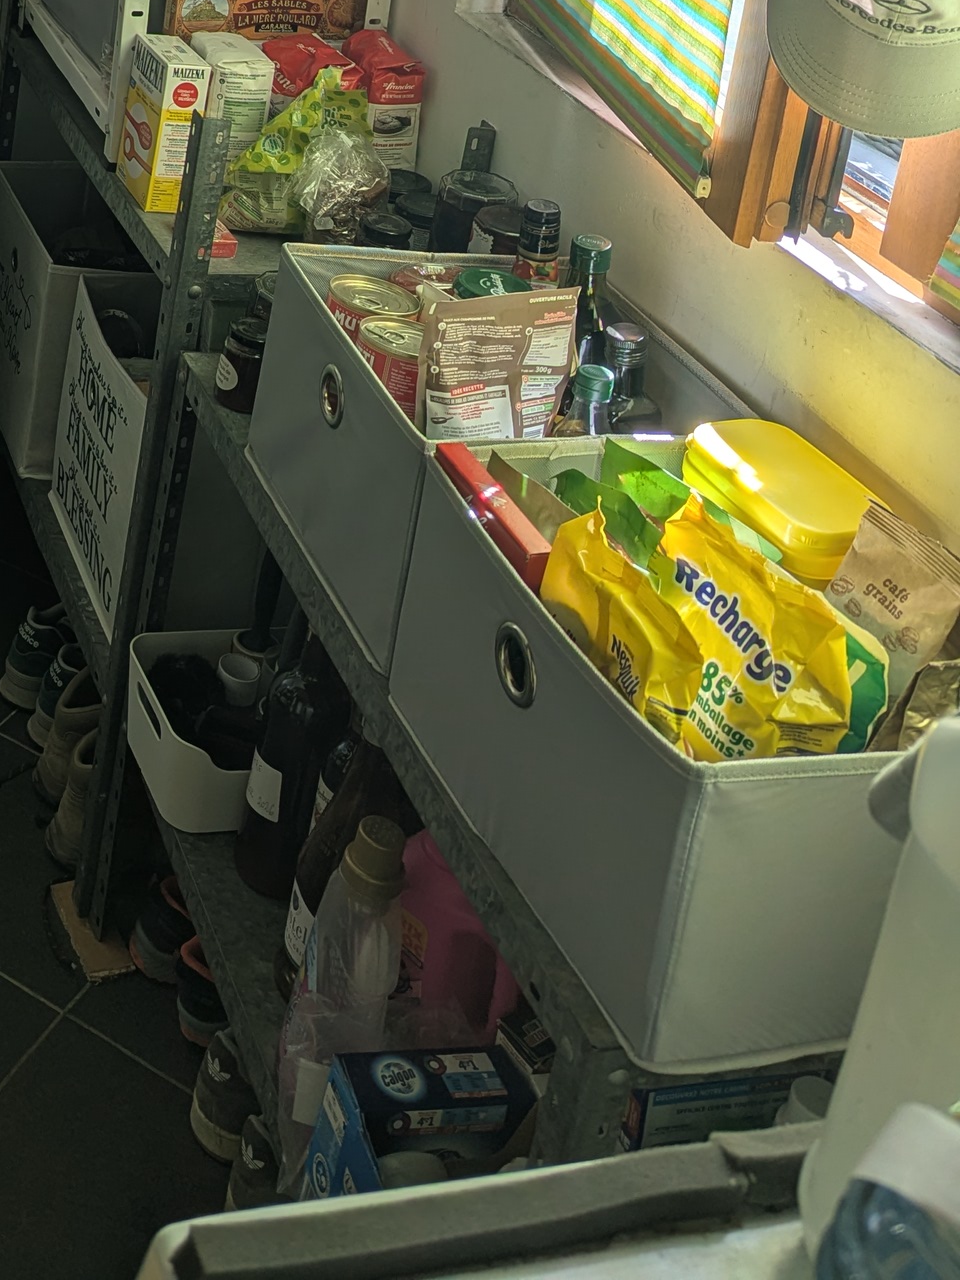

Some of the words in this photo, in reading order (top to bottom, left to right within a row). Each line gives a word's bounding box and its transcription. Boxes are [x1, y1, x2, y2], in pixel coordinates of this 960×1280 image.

[252, 1, 269, 10] LES
[238, 15, 251, 27] LA
[277, 13, 317, 27] POULARD
[172, 67, 205, 80] MAIZENA
[529, 295, 556, 304] OUVERTURE
[334, 309, 361, 331] MU
[535, 366, 552, 374] 300g
[75, 344, 117, 454] HOME
[65, 400, 113, 524] FAMILY
[56, 456, 112, 613] BLESSING
[863, 583, 903, 620] grains
[882, 578, 911, 603] café
[675, 557, 792, 693] Recharge
[611, 634, 640, 697] Nesquik
[380, 1068, 417, 1087] Calgon
